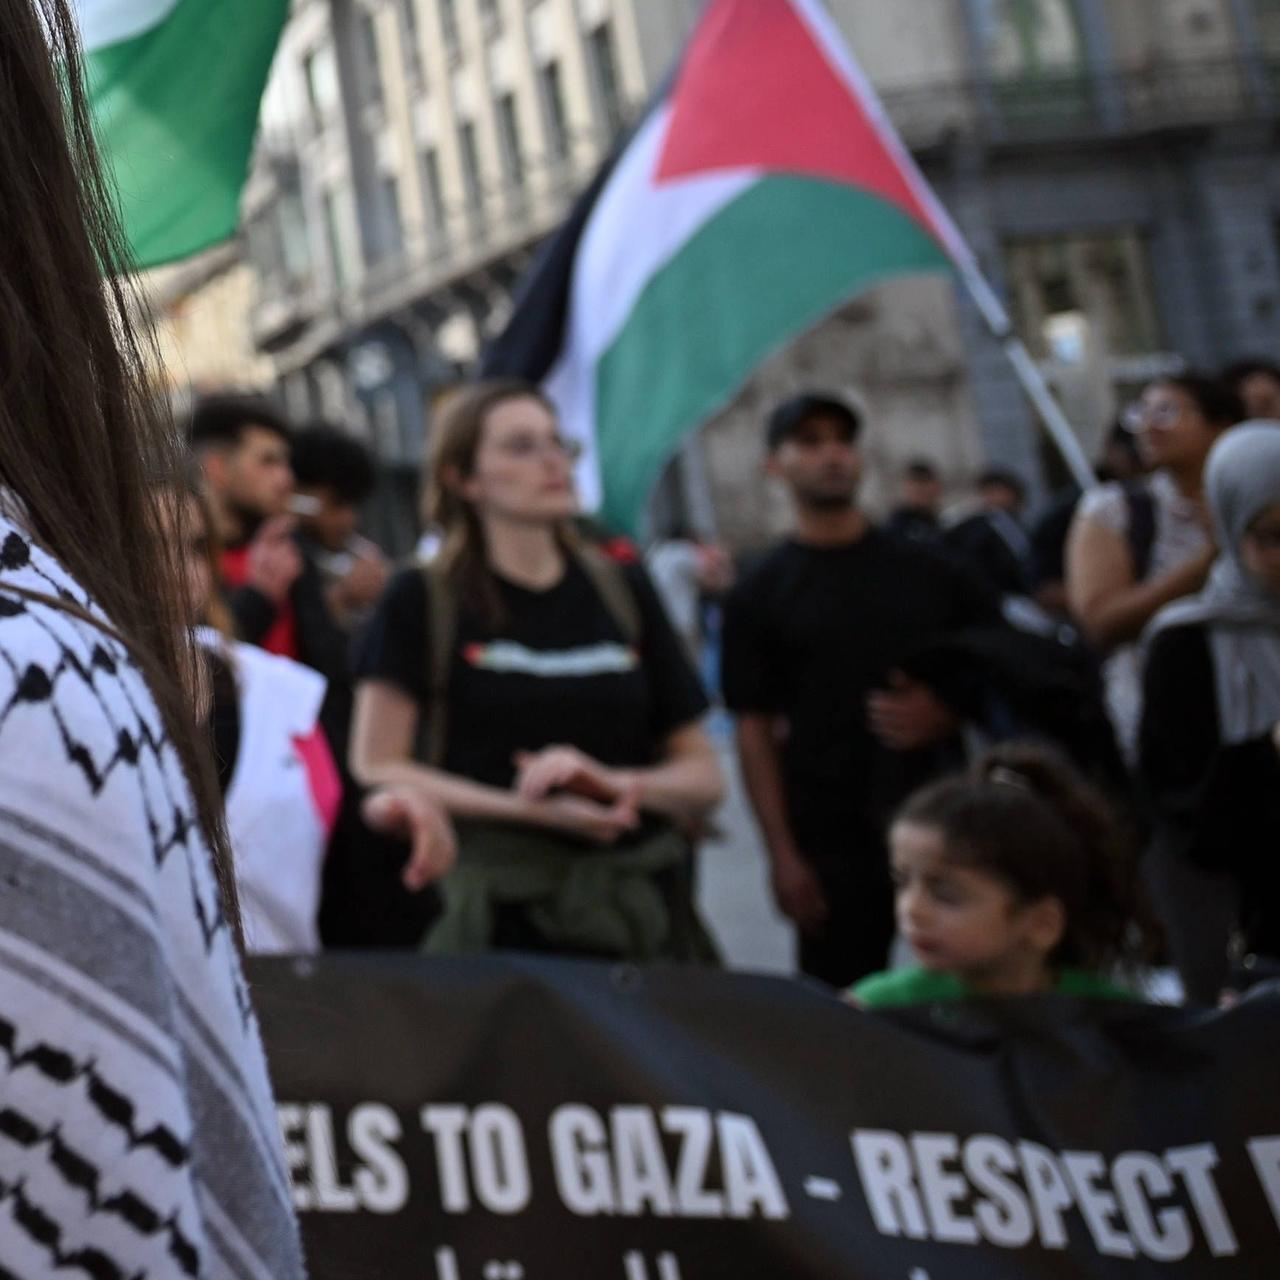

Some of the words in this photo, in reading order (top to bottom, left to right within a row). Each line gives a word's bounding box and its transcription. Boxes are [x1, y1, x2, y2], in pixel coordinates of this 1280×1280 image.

[419, 1101, 533, 1215] TO
[546, 1101, 791, 1220] GAZA
[848, 1126, 1239, 1263] RESPECT
